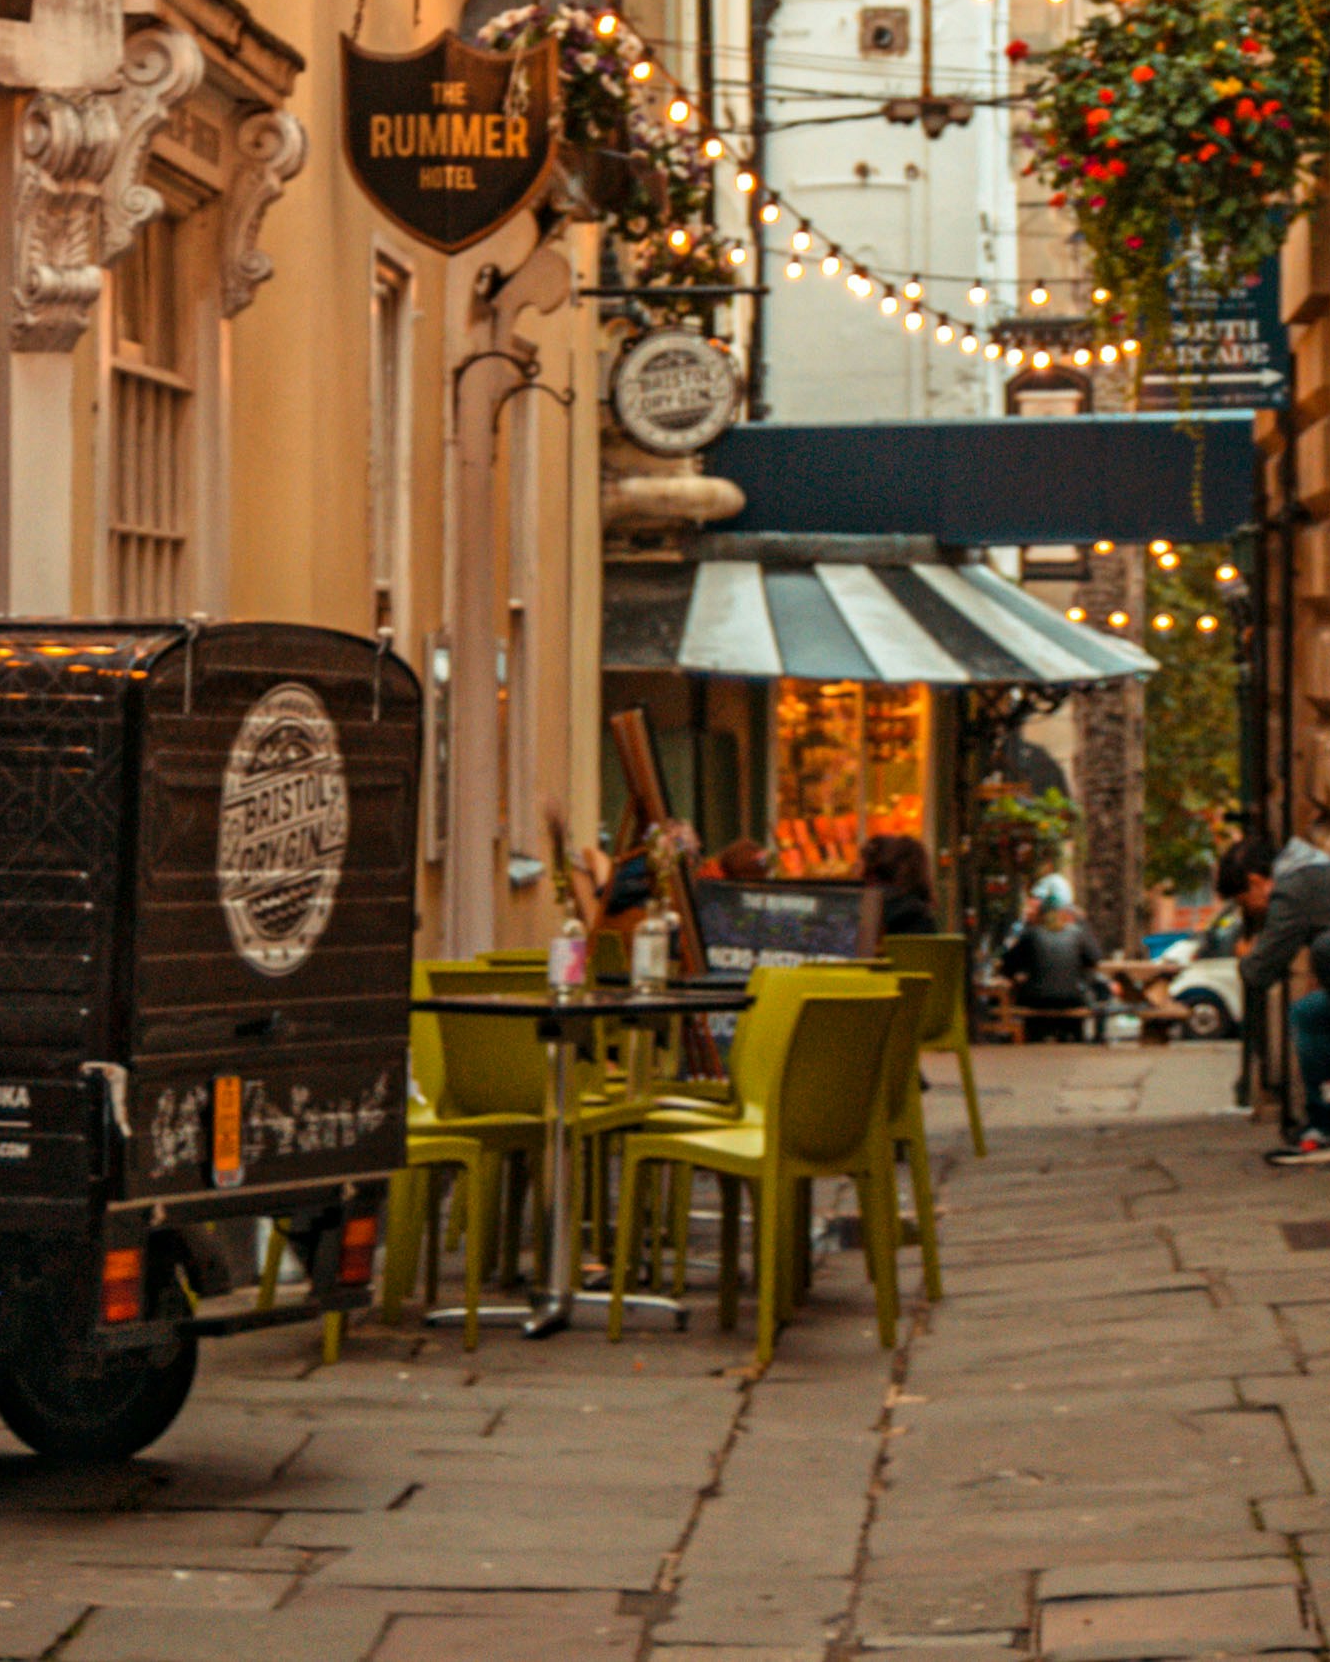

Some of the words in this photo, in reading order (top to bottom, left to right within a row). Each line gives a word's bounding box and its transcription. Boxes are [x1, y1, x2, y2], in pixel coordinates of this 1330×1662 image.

[431, 81, 469, 107] THE
[369, 112, 531, 159] RUMMER
[419, 164, 478, 191] HOTEL
[244, 773, 330, 835] BRISTOL
